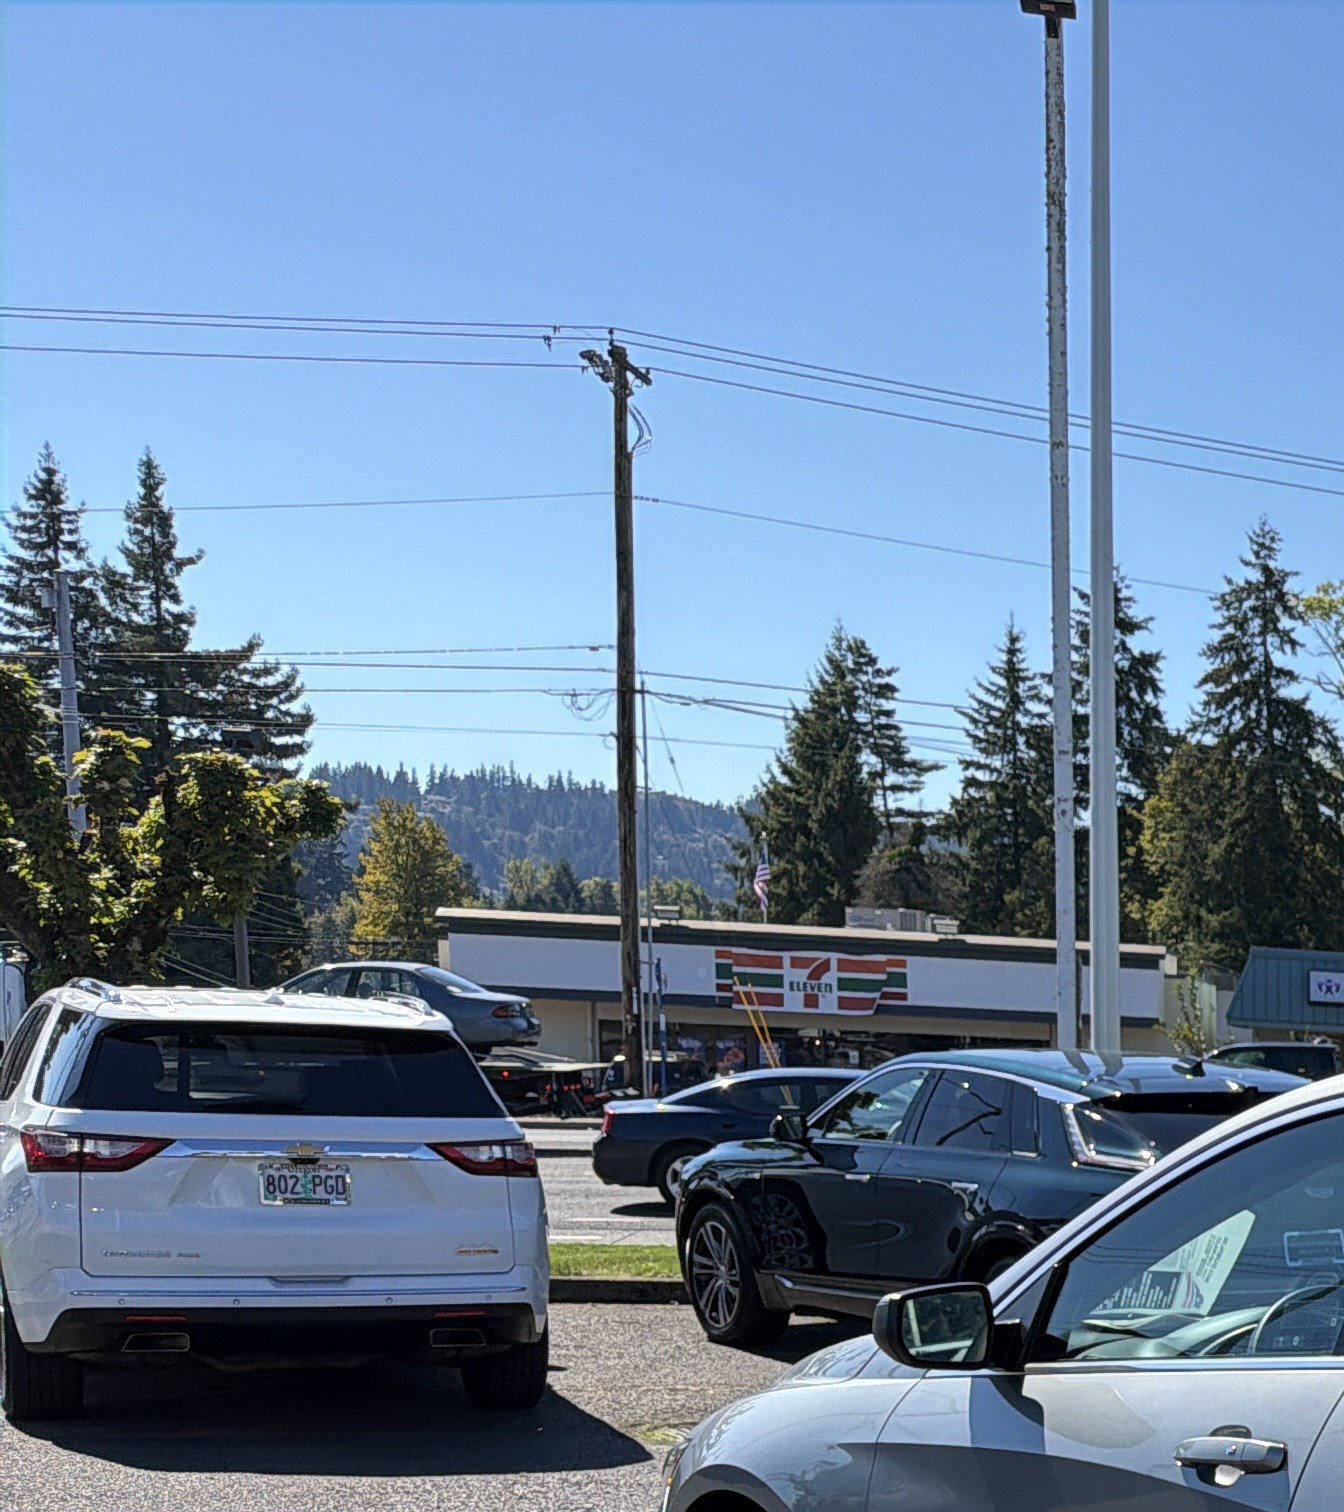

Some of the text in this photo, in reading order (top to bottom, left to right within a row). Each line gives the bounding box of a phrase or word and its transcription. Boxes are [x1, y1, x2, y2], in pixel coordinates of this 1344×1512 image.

[790, 955, 831, 1009] 7
[266, 1174, 347, 1196] 802 PGD
